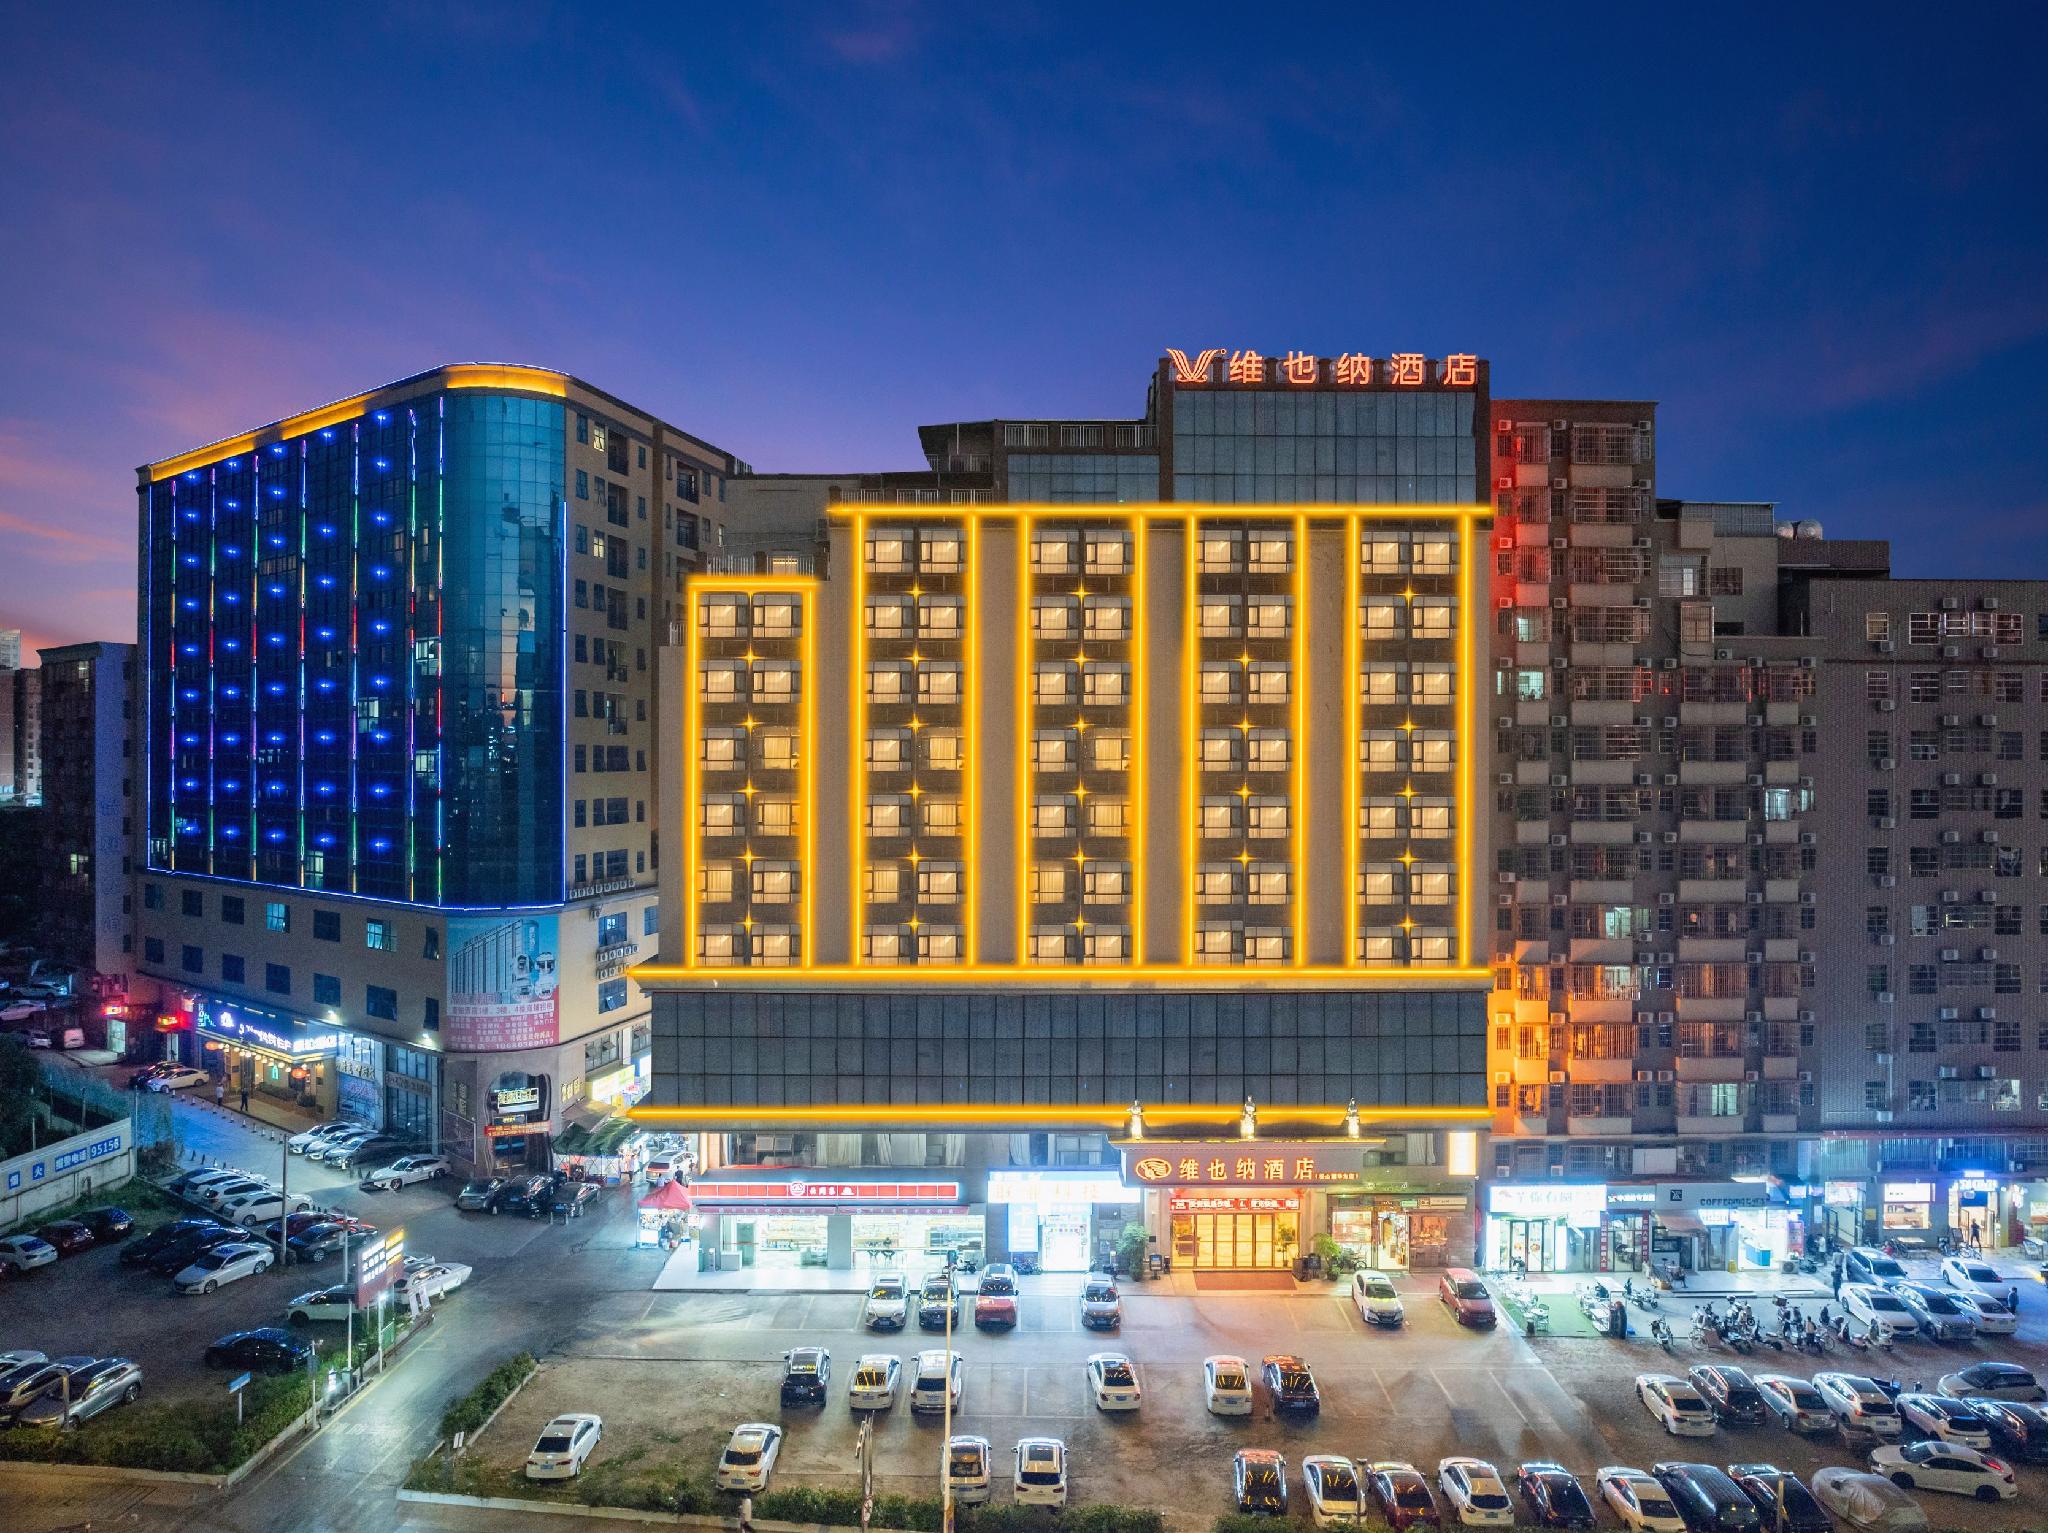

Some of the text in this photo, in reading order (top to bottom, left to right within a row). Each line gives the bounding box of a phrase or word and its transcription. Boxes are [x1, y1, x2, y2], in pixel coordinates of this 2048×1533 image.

[1229, 350, 1478, 385] 维也纳酒店
[1179, 1157, 1315, 1181] 维也纳酒店
